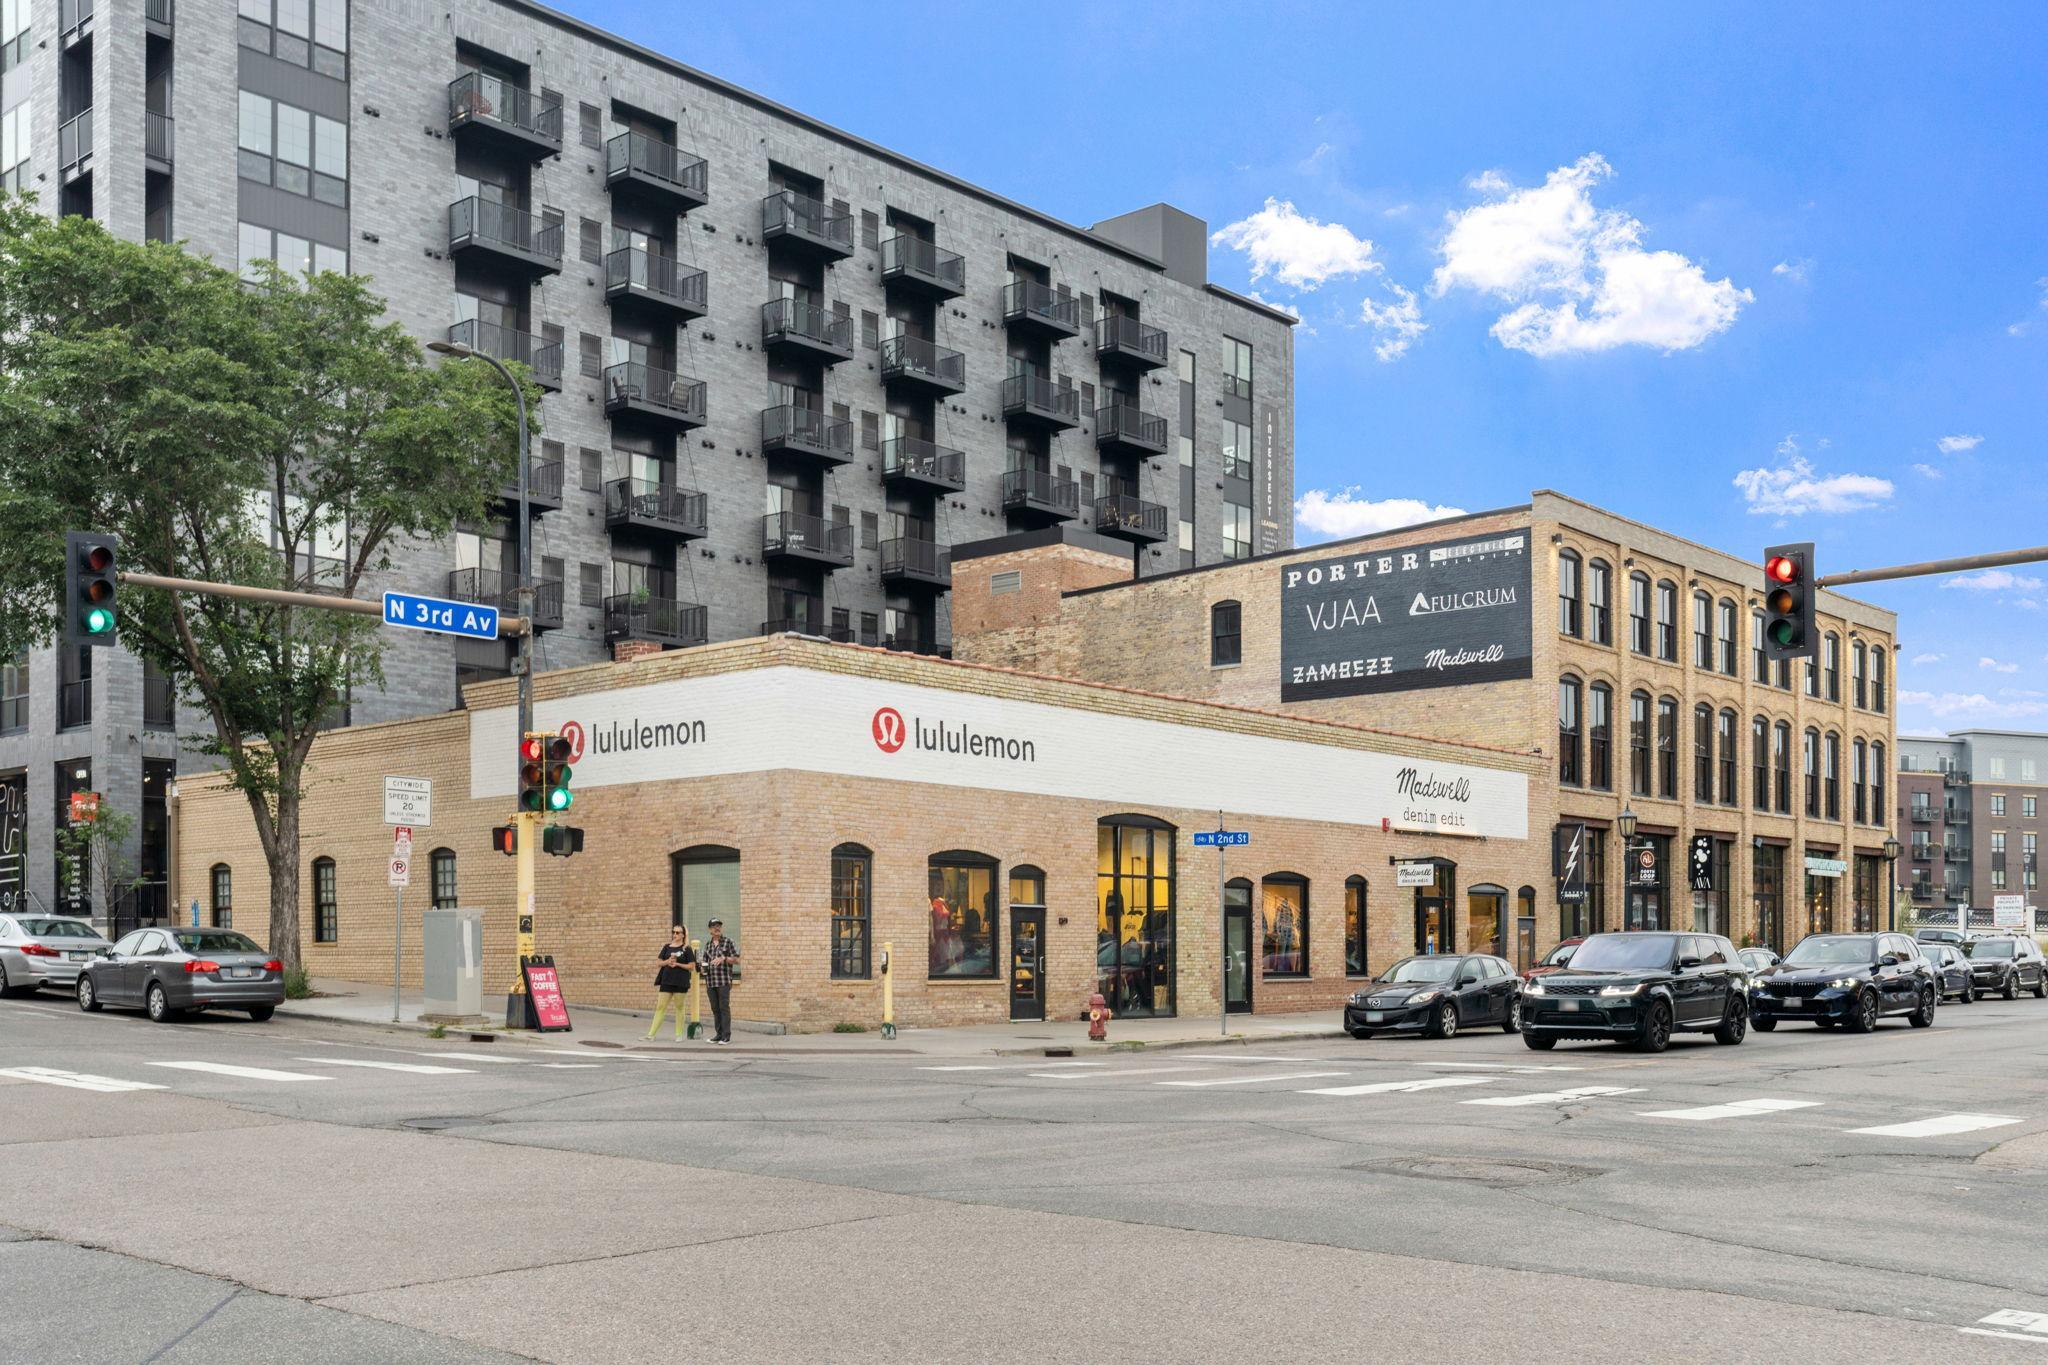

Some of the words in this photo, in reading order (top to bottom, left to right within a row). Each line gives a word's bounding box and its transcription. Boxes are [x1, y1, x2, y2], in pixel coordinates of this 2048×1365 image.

[1287, 552, 1419, 589] PORTER
[1447, 541, 1504, 557] ELECTRIC
[1430, 549, 1522, 568] BUILDING
[1431, 587, 1517, 612] FULCRUM
[390, 599, 405, 619] N
[416, 603, 453, 626] 3rd
[463, 610, 491, 632] Av
[1306, 596, 1382, 631] VJAA
[1424, 644, 1504, 671] Madewell
[1293, 656, 1393, 684] ZAMBEZI
[592, 718, 706, 755] lululemon
[915, 717, 1036, 762] lululemon
[393, 780, 424, 789] CITYWIDE
[1396, 767, 1471, 803] Madewell
[388, 792, 409, 800] SPEED
[402, 802, 414, 811] 20
[1403, 806, 1437, 824] denim
[1440, 811, 1466, 827] edit
[1208, 834, 1215, 844] N
[1217, 834, 1234, 844] 2nd
[1237, 833, 1247, 843] St
[1399, 868, 1432, 878] Madewell
[1693, 876, 1711, 889] AVA
[531, 973, 547, 981] FAST
[533, 982, 557, 991] COFFEE
